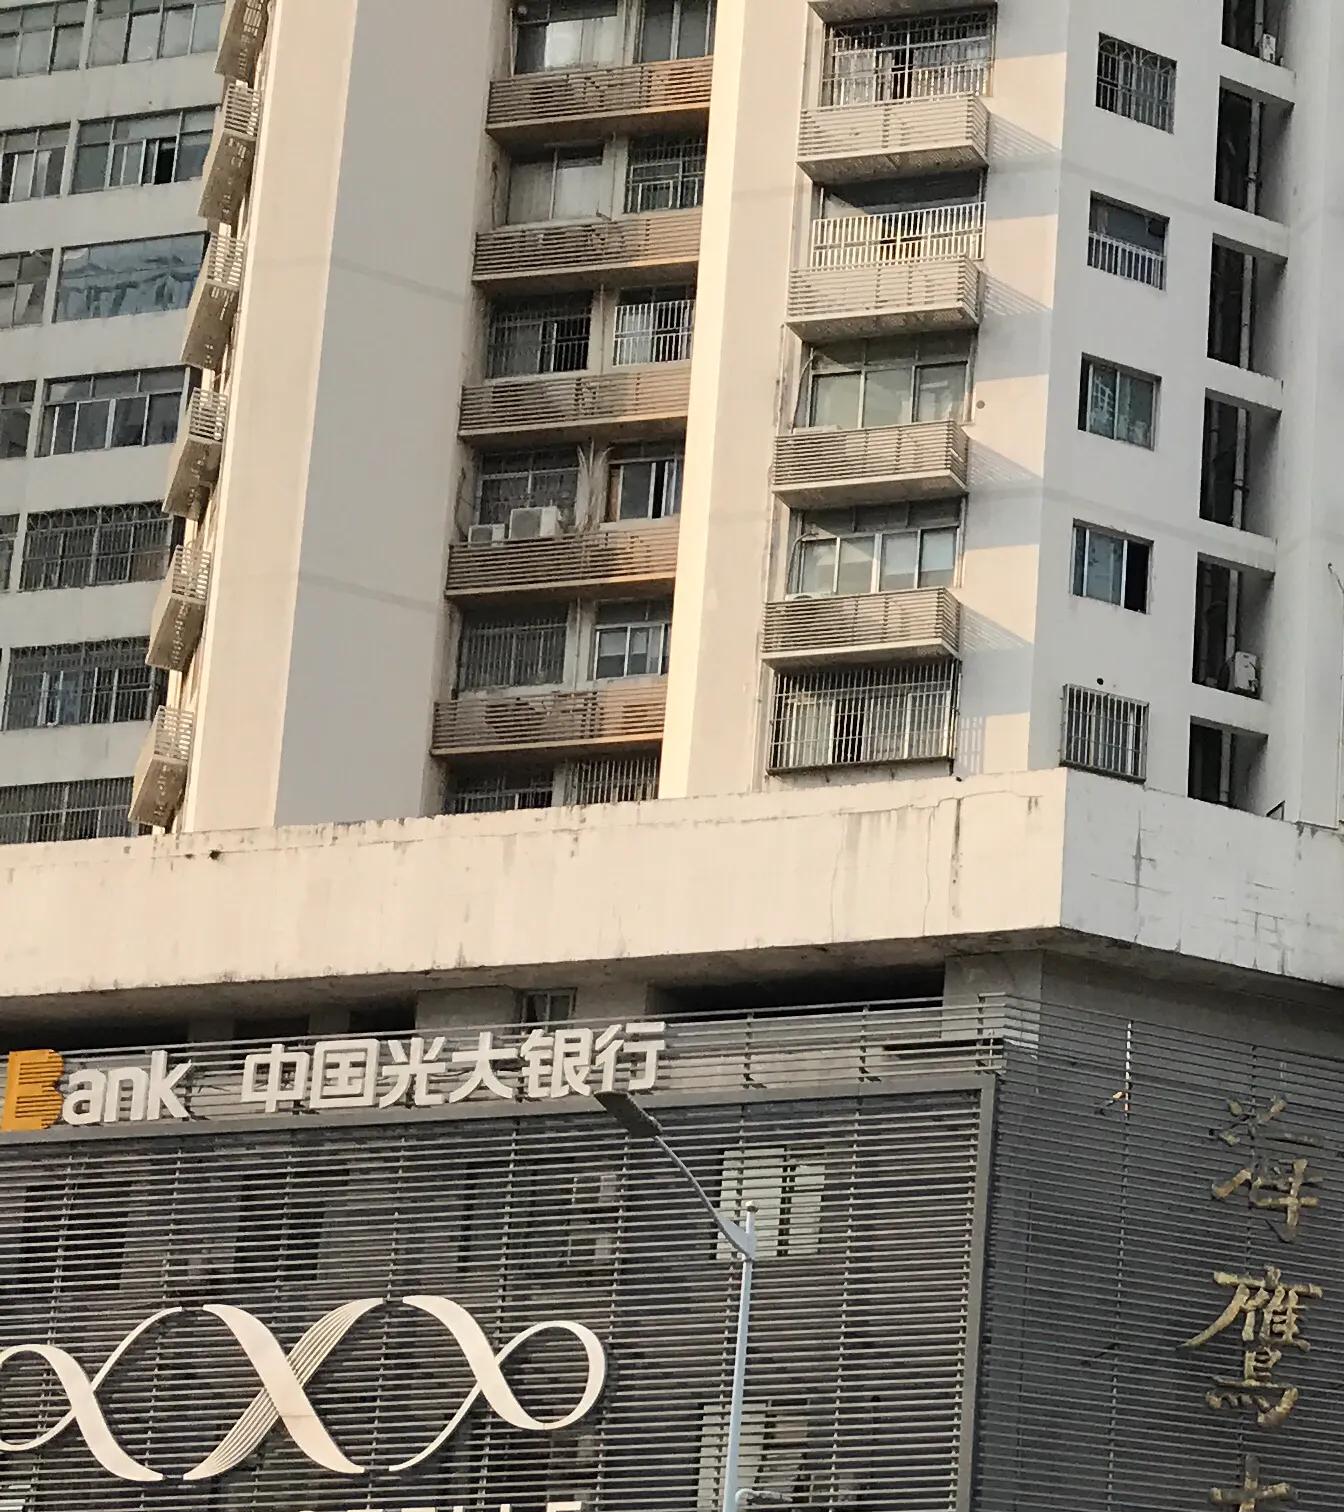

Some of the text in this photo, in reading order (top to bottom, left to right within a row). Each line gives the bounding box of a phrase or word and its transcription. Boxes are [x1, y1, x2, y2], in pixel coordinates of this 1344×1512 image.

[2, 1049, 192, 1131] Bank
[241, 1021, 667, 1114] 中国光大银行
